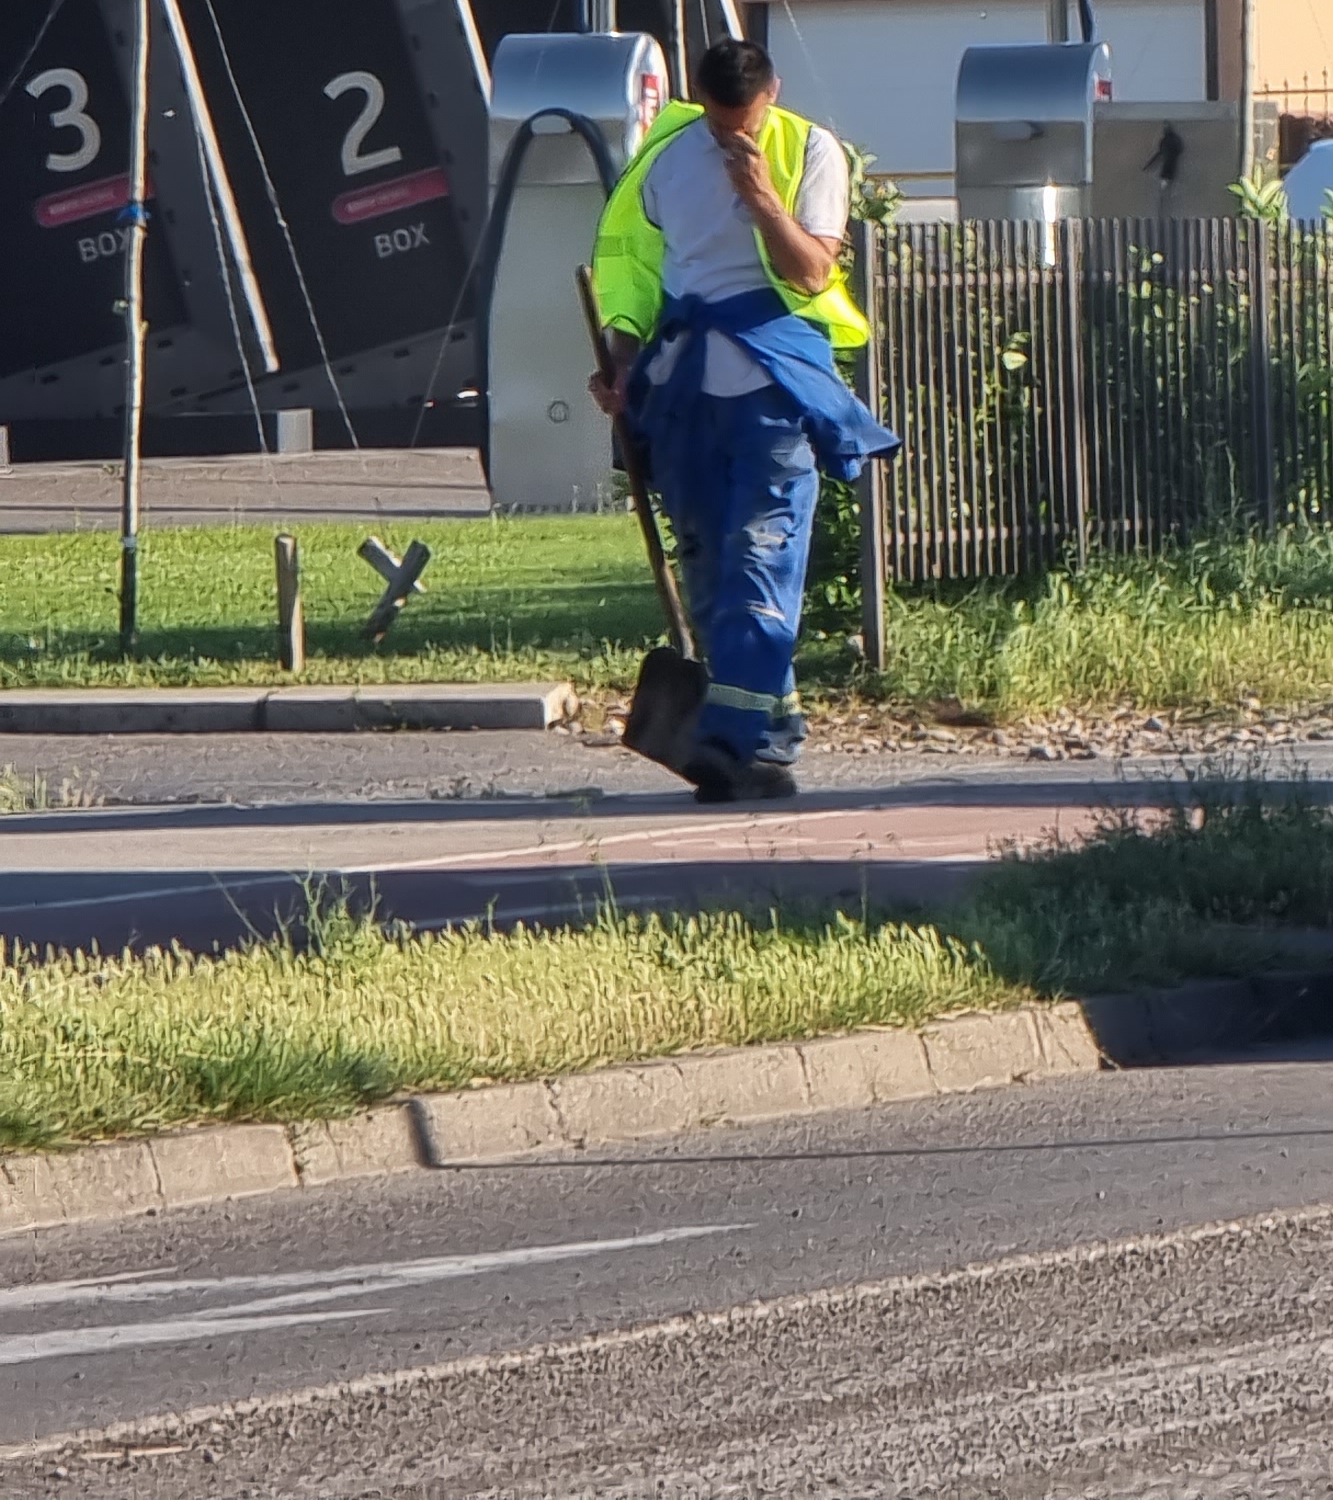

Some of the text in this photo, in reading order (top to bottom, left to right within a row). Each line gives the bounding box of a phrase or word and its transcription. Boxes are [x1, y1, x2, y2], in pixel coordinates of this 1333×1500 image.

[26, 68, 101, 172] 3
[323, 71, 402, 176] 2
[78, 228, 131, 262] BOX
[374, 222, 430, 258] BOX
